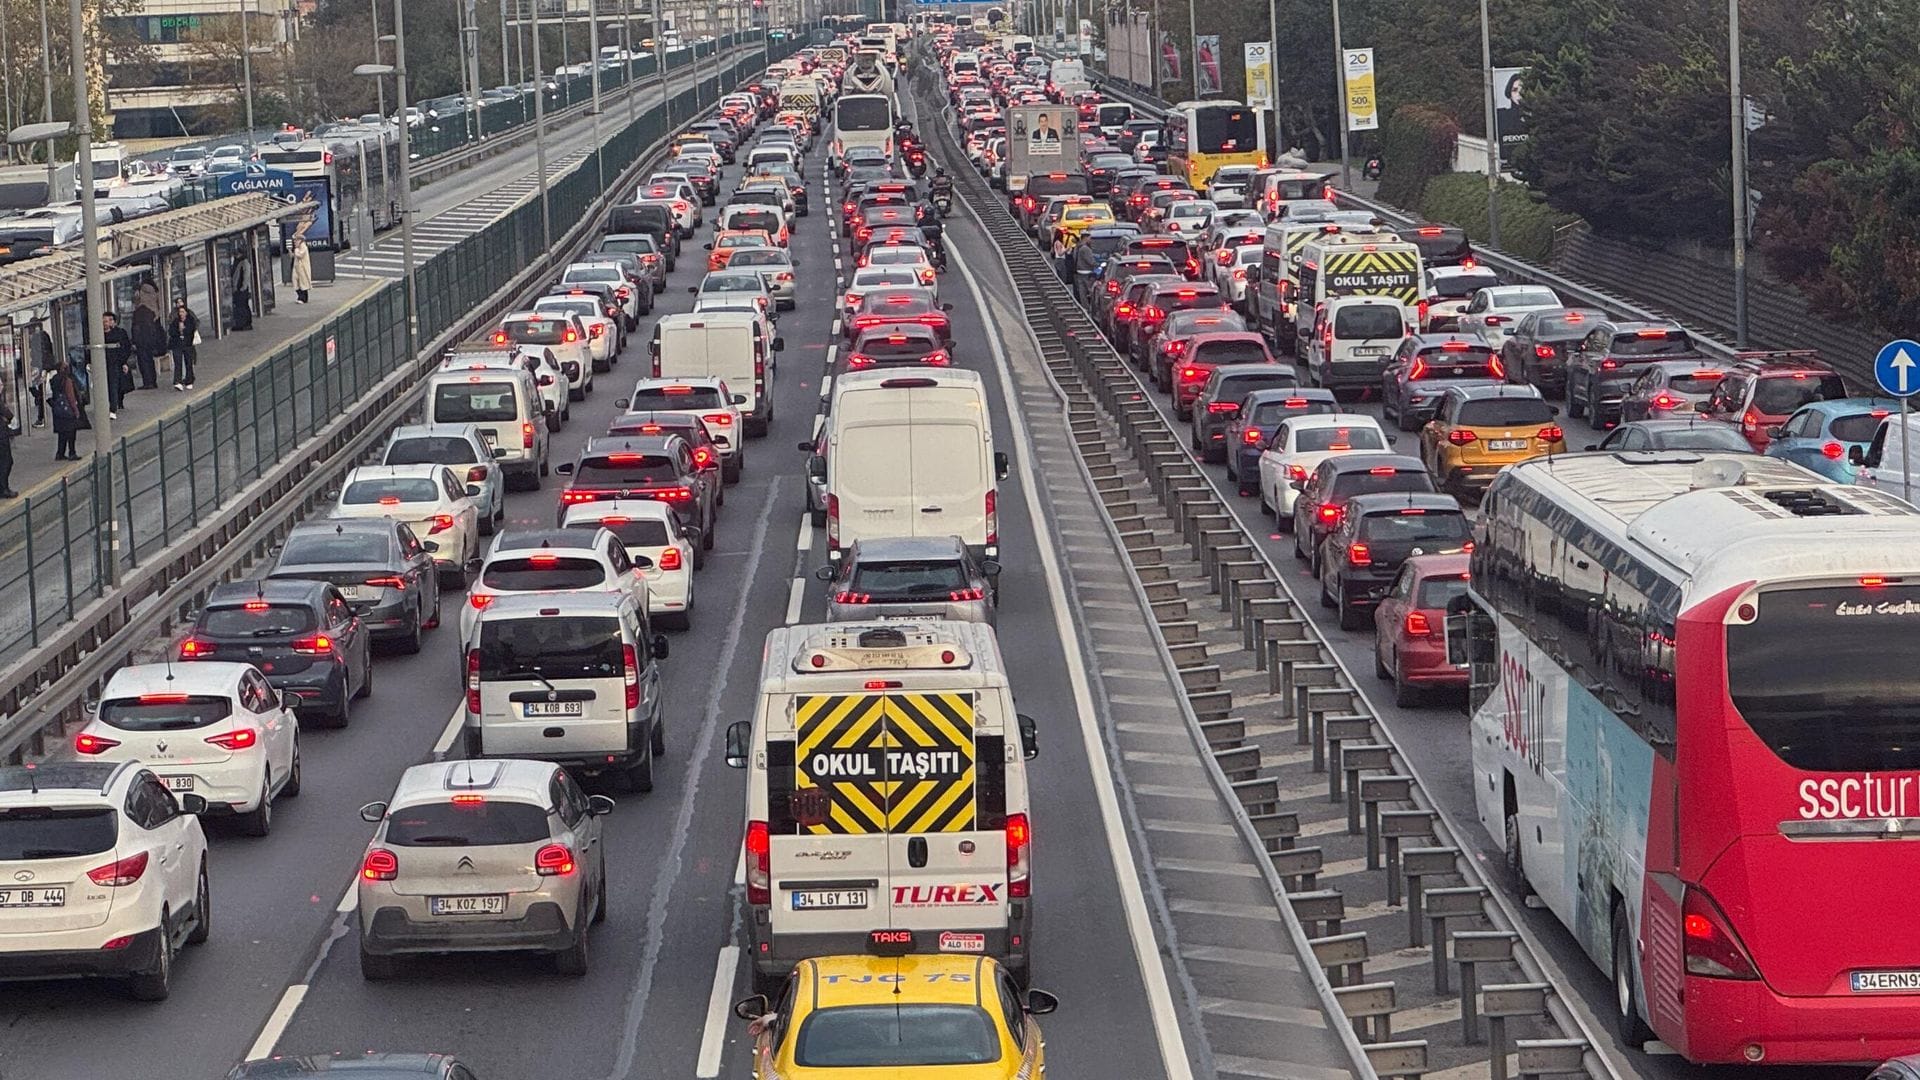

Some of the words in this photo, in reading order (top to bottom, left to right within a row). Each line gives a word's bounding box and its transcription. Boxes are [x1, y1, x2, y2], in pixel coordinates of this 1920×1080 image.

[1349, 53, 1368, 65] 20
[231, 179, 283, 192] ÇAĞLAYAN
[1334, 276, 1367, 286] OKUL
[1371, 275, 1409, 287] TAŞITI
[529, 703, 540, 713] 34
[564, 702, 581, 713] 693
[812, 753, 876, 776] OKUL
[886, 751, 959, 779] TAŞITI
[176, 778, 192, 788] 830
[43, 890, 63, 902] 444
[800, 893, 814, 906] 34
[820, 892, 840, 905] LGY
[847, 892, 864, 904] 131
[892, 882, 1004, 904] TUREX
[440, 899, 451, 910] 34
[482, 897, 500, 909] 197
[923, 972, 971, 983] 75
[1860, 973, 1920, 988] 34ERN9
